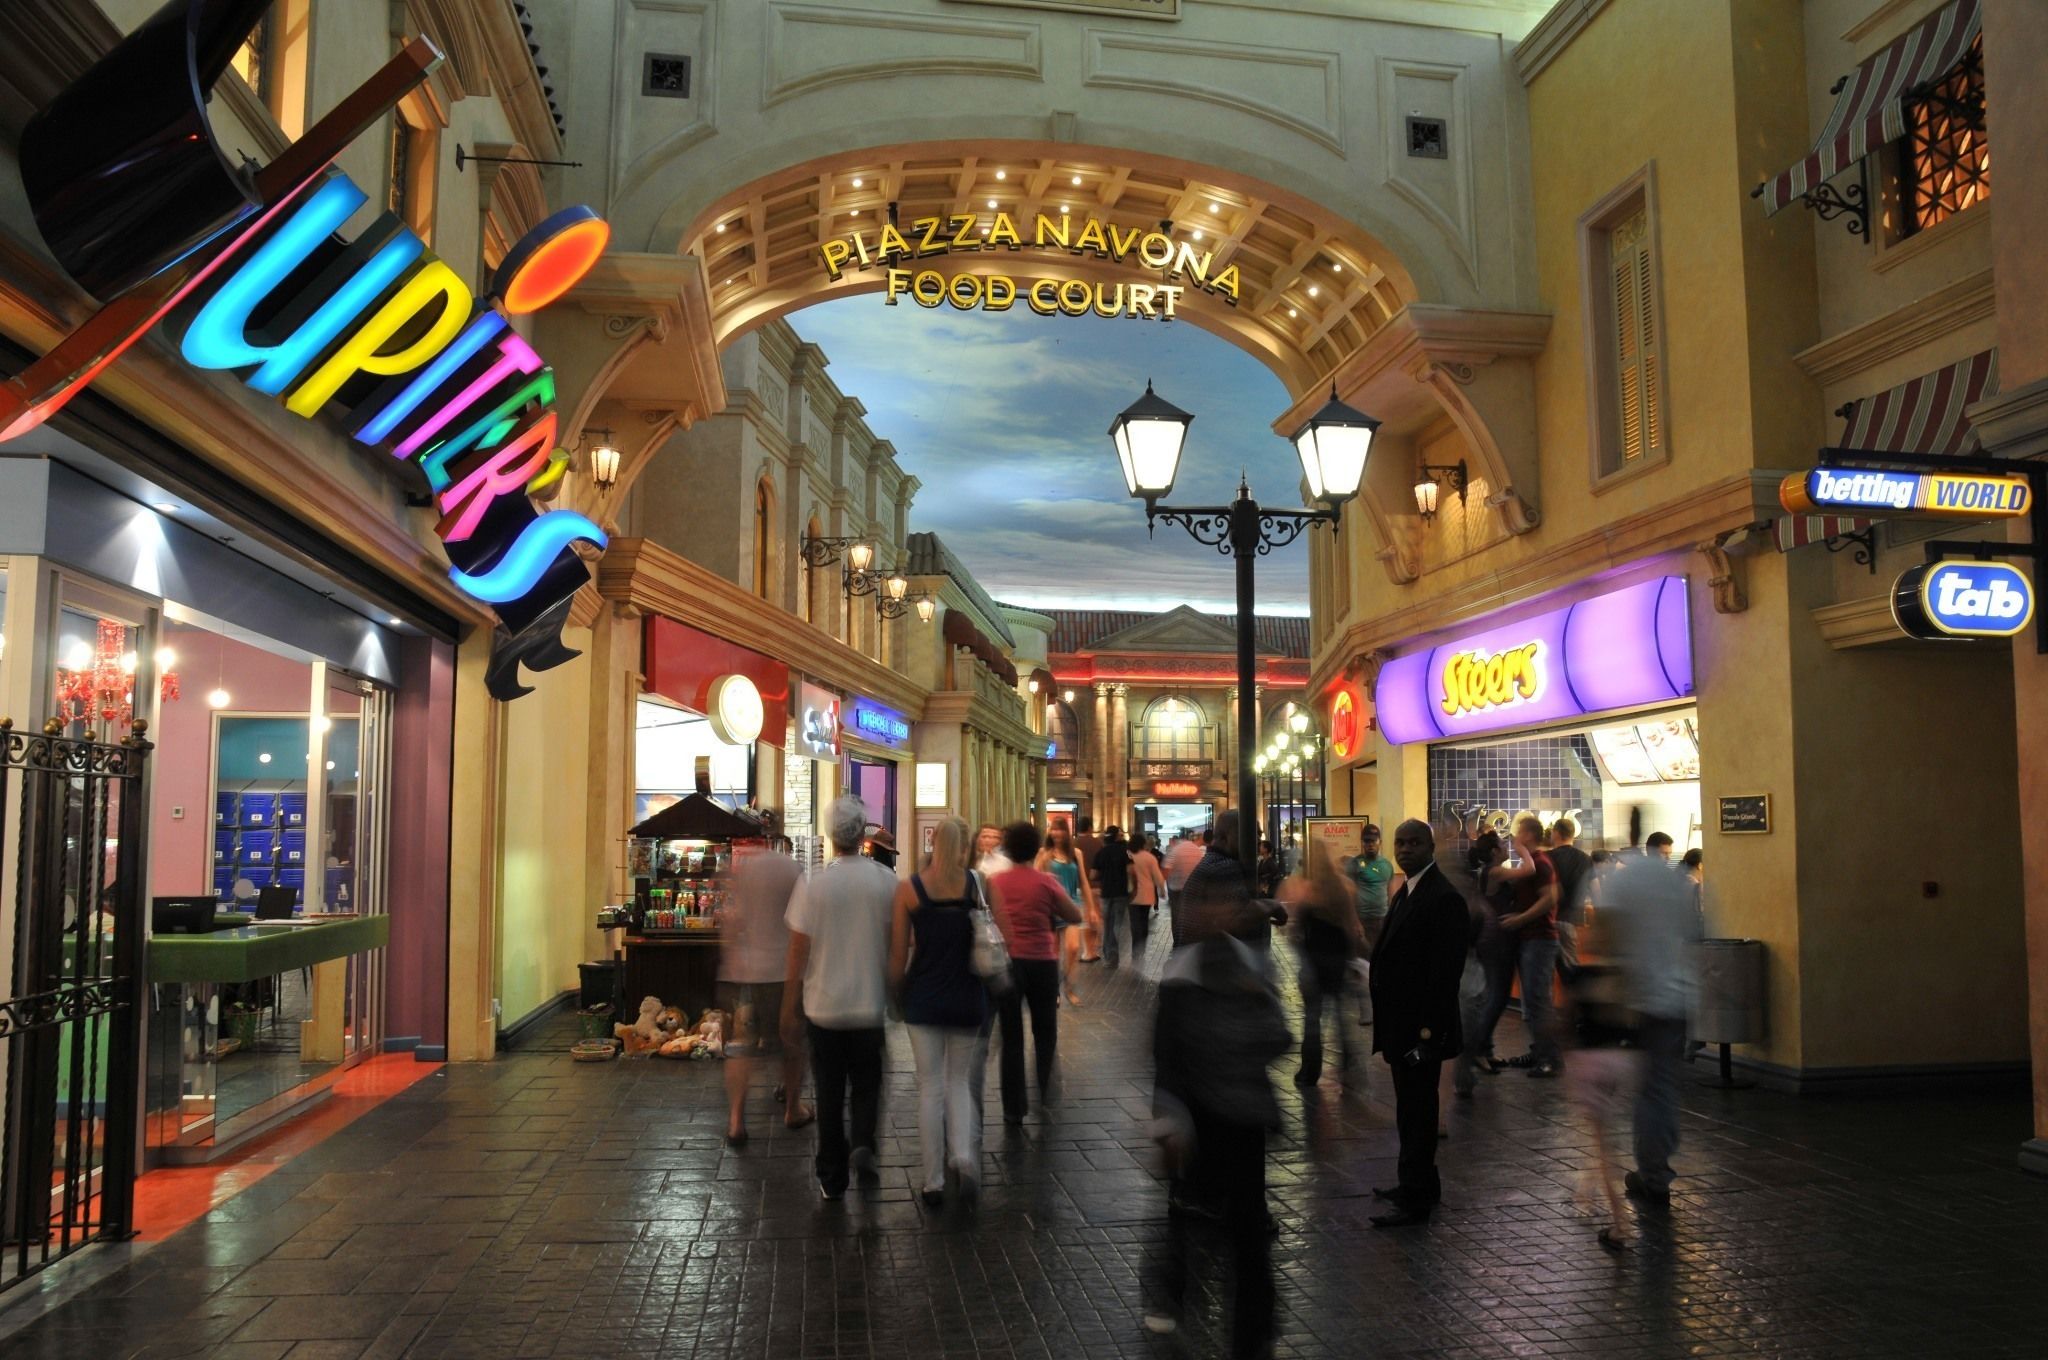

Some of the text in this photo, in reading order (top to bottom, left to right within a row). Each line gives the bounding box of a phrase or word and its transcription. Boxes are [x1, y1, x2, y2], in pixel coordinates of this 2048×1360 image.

[820, 211, 1242, 305] PIAZZA NAVONA
[886, 268, 1184, 321] FOOD COURT
[1816, 471, 2028, 511] betting WORLD
[1938, 572, 2025, 618] tab
[1441, 643, 1539, 715] Steers
